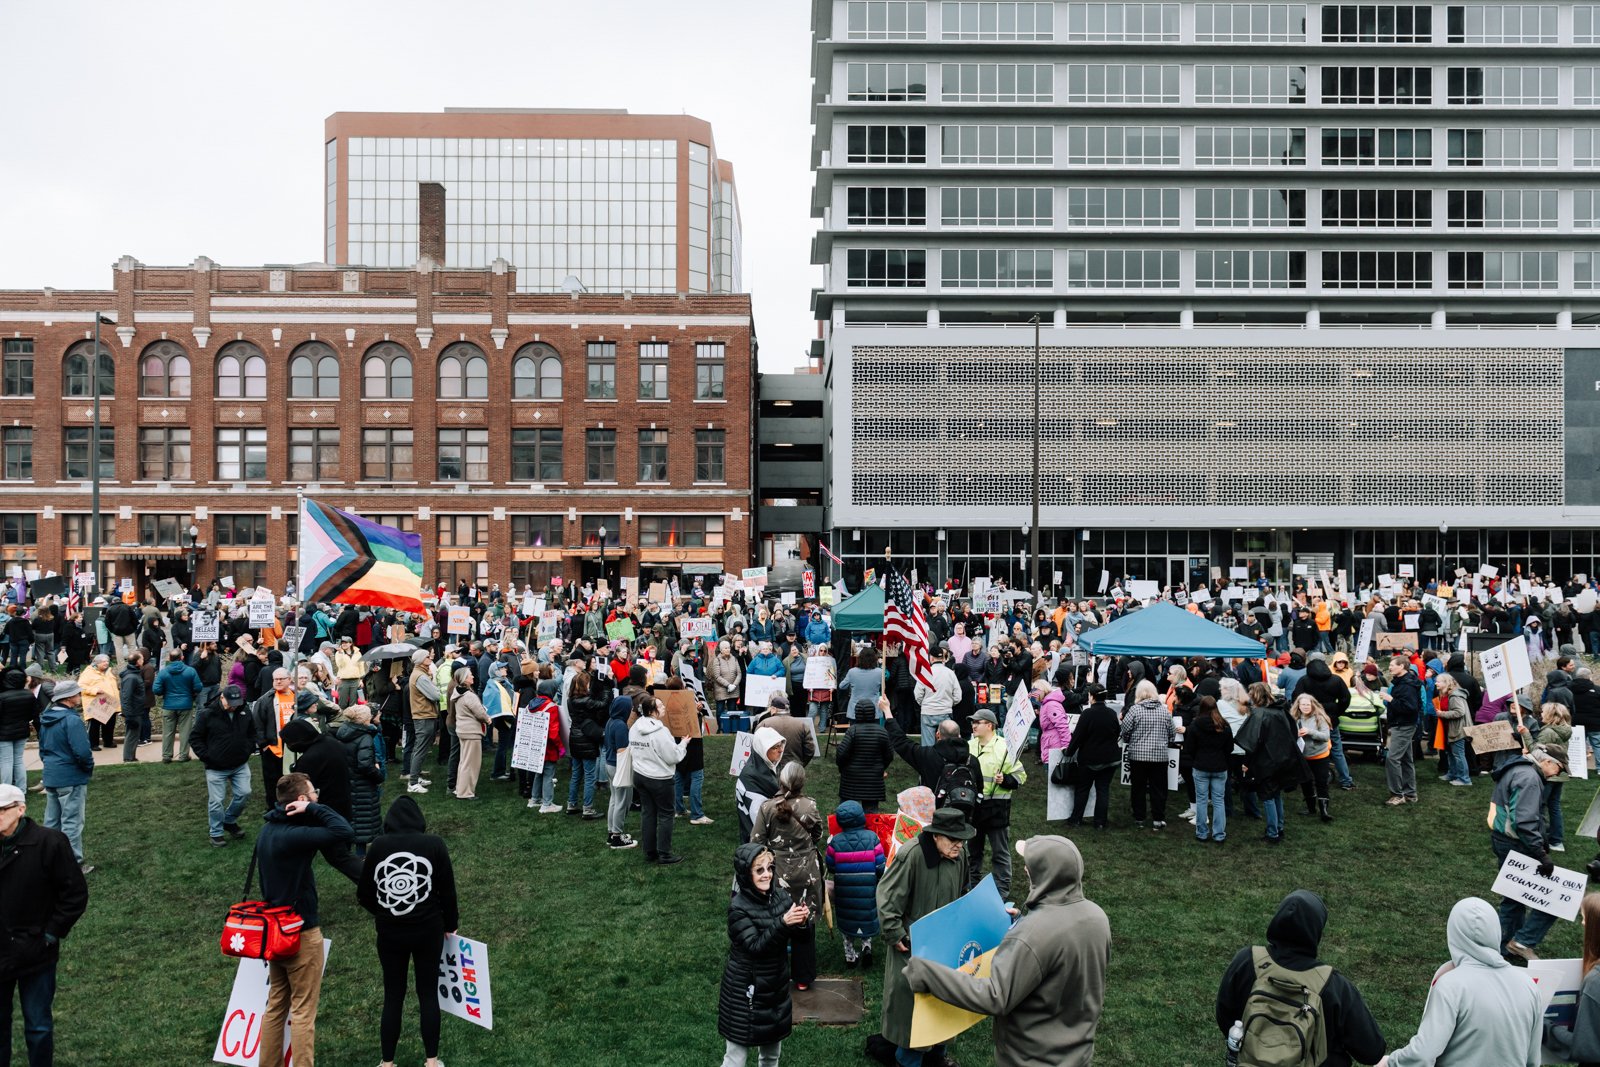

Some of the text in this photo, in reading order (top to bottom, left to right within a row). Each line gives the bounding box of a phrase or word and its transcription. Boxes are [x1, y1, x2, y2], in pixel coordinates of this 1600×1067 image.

[802, 571, 813, 581] TAX
[1487, 660, 1502, 670] HANDS
[1505, 873, 1571, 902] COUNTRY TO
[1507, 858, 1530, 871] BUY
[1562, 880, 1583, 890] OWN
[446, 953, 462, 1004] OUR
[459, 939, 481, 1019] RIGHTS
